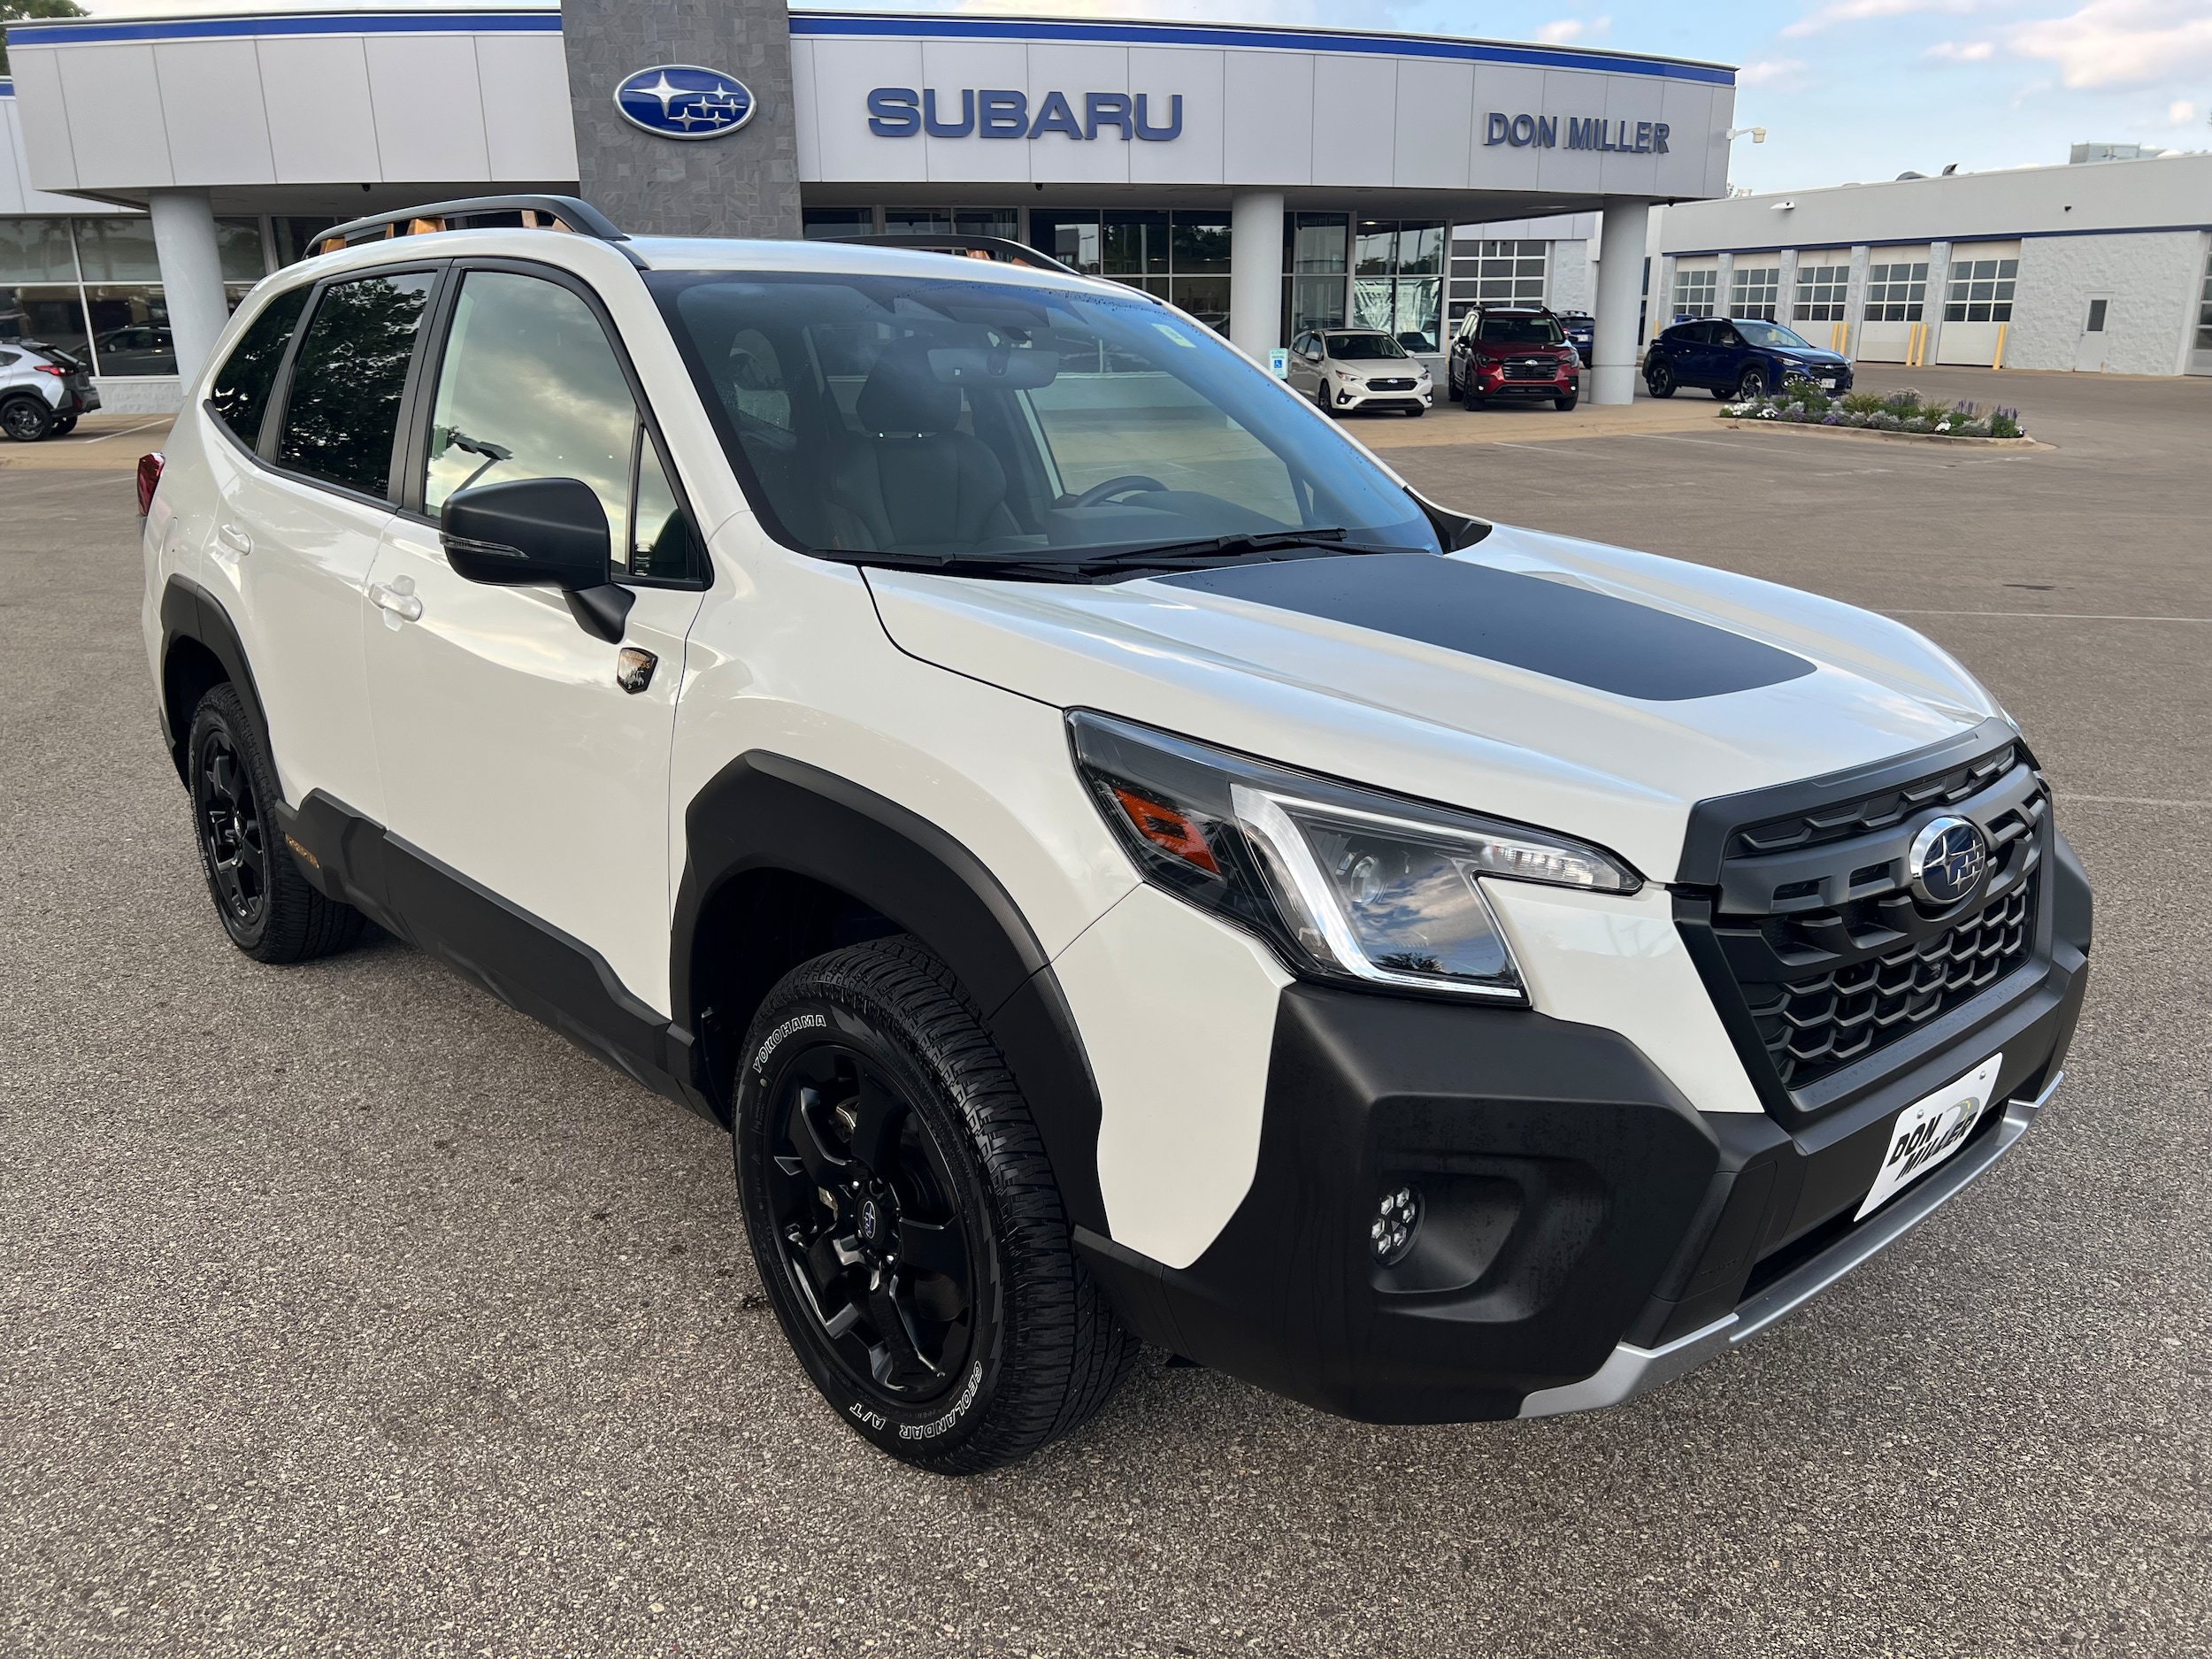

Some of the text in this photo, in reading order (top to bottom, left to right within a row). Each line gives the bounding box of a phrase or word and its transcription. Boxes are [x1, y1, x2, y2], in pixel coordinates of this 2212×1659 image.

[867, 88, 1183, 141] SUBARU
[1483, 112, 1671, 154] DON MILLER
[752, 1014, 826, 1074] YOKOHAMA
[1886, 1112, 1944, 1167] DON
[1895, 1111, 1978, 1182] MILLER
[849, 1360, 982, 1440] GEOLANDAR A/T
